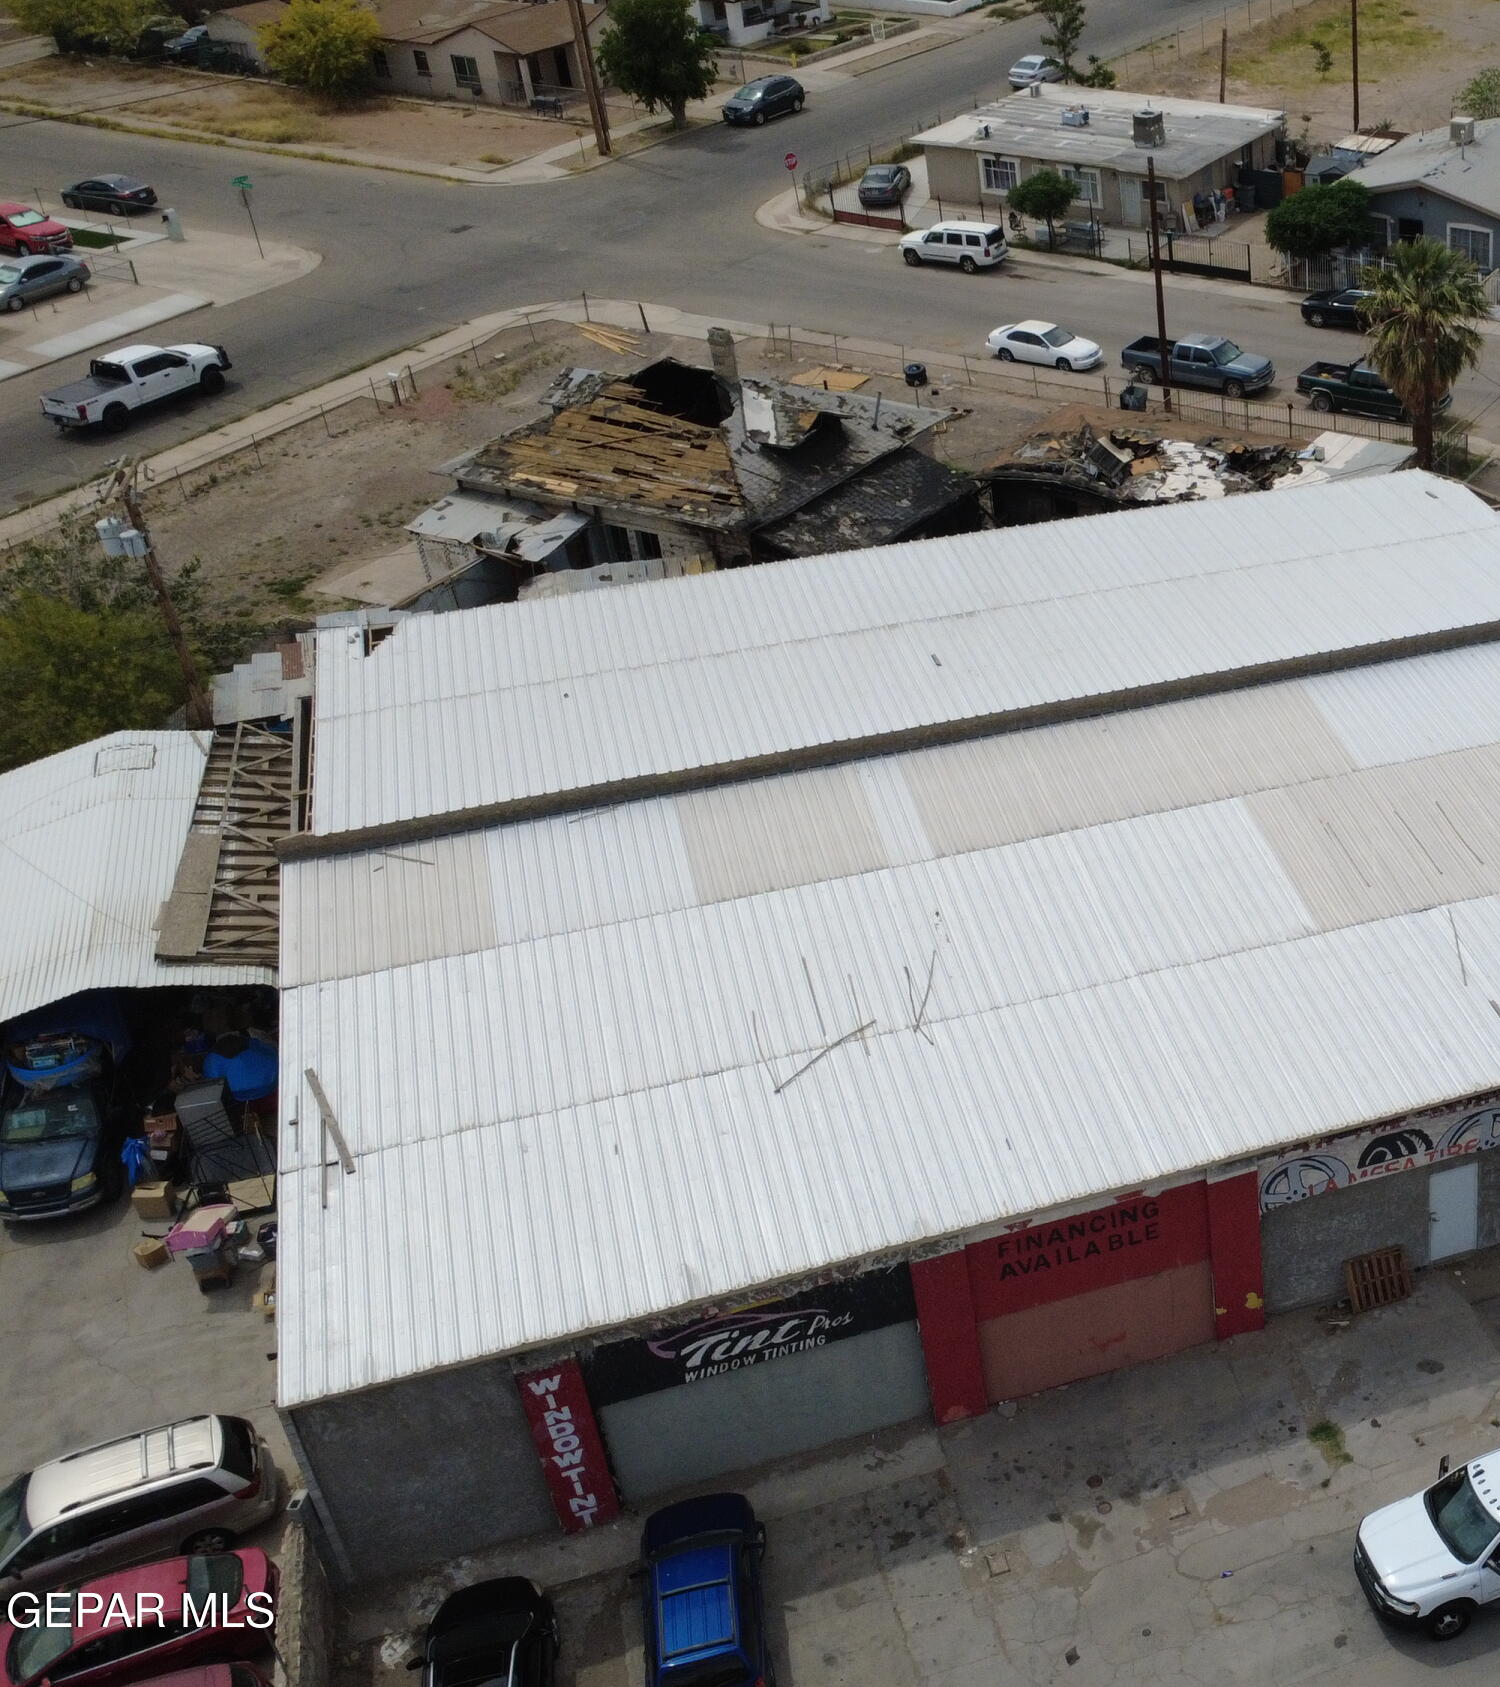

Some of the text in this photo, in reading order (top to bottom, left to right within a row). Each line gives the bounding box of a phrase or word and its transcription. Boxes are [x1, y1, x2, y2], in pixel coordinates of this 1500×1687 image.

[997, 1200, 1160, 1259] FINANCING
[1000, 1223, 1160, 1281] AVAILABLE
[681, 1311, 854, 1368] Tint Pros
[684, 1334, 826, 1384] WINDOW TINTING
